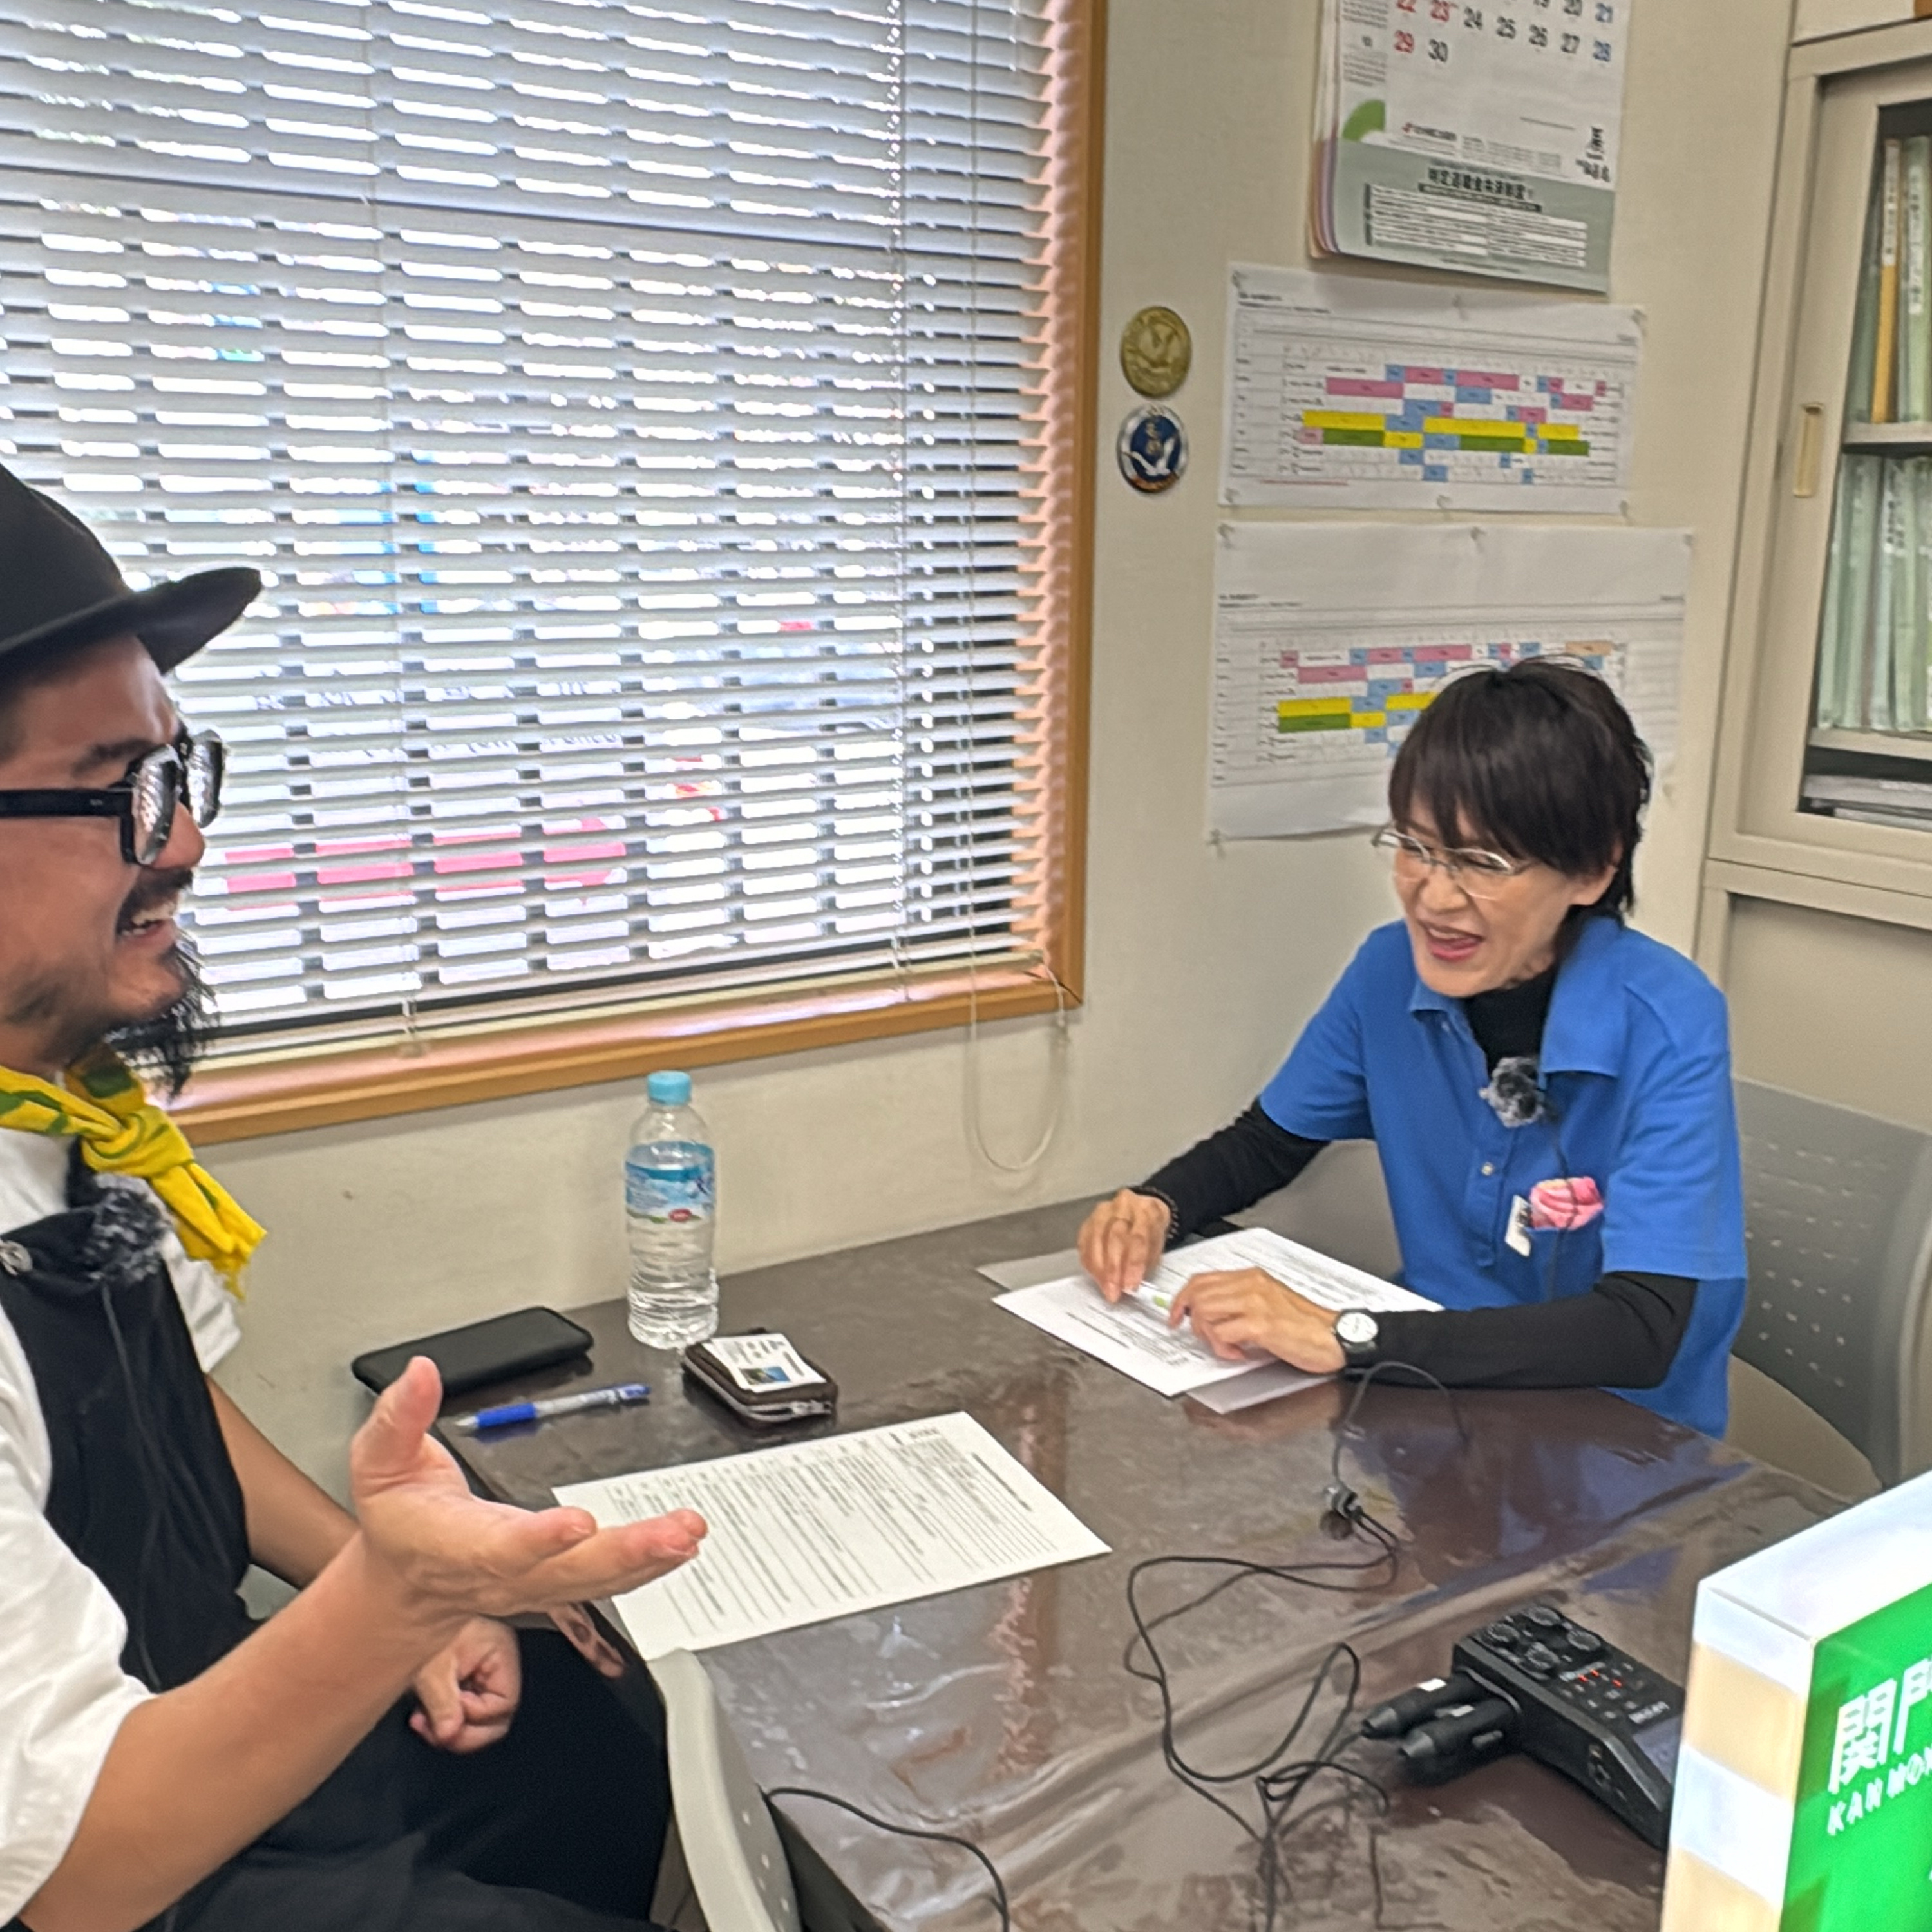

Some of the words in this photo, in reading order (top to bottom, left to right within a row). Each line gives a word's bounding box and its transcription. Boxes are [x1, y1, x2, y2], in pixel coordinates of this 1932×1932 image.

[1394, 29, 1415, 53] 29
[1428, 38, 1448, 63] 30
[1463, 6, 1483, 30] 24
[1496, 15, 1516, 39] 25
[1528, 24, 1548, 48] 26
[1560, 32, 1580, 54] 27
[1592, 40, 1612, 62] 28
[1826, 1777, 1884, 1836] KAN
